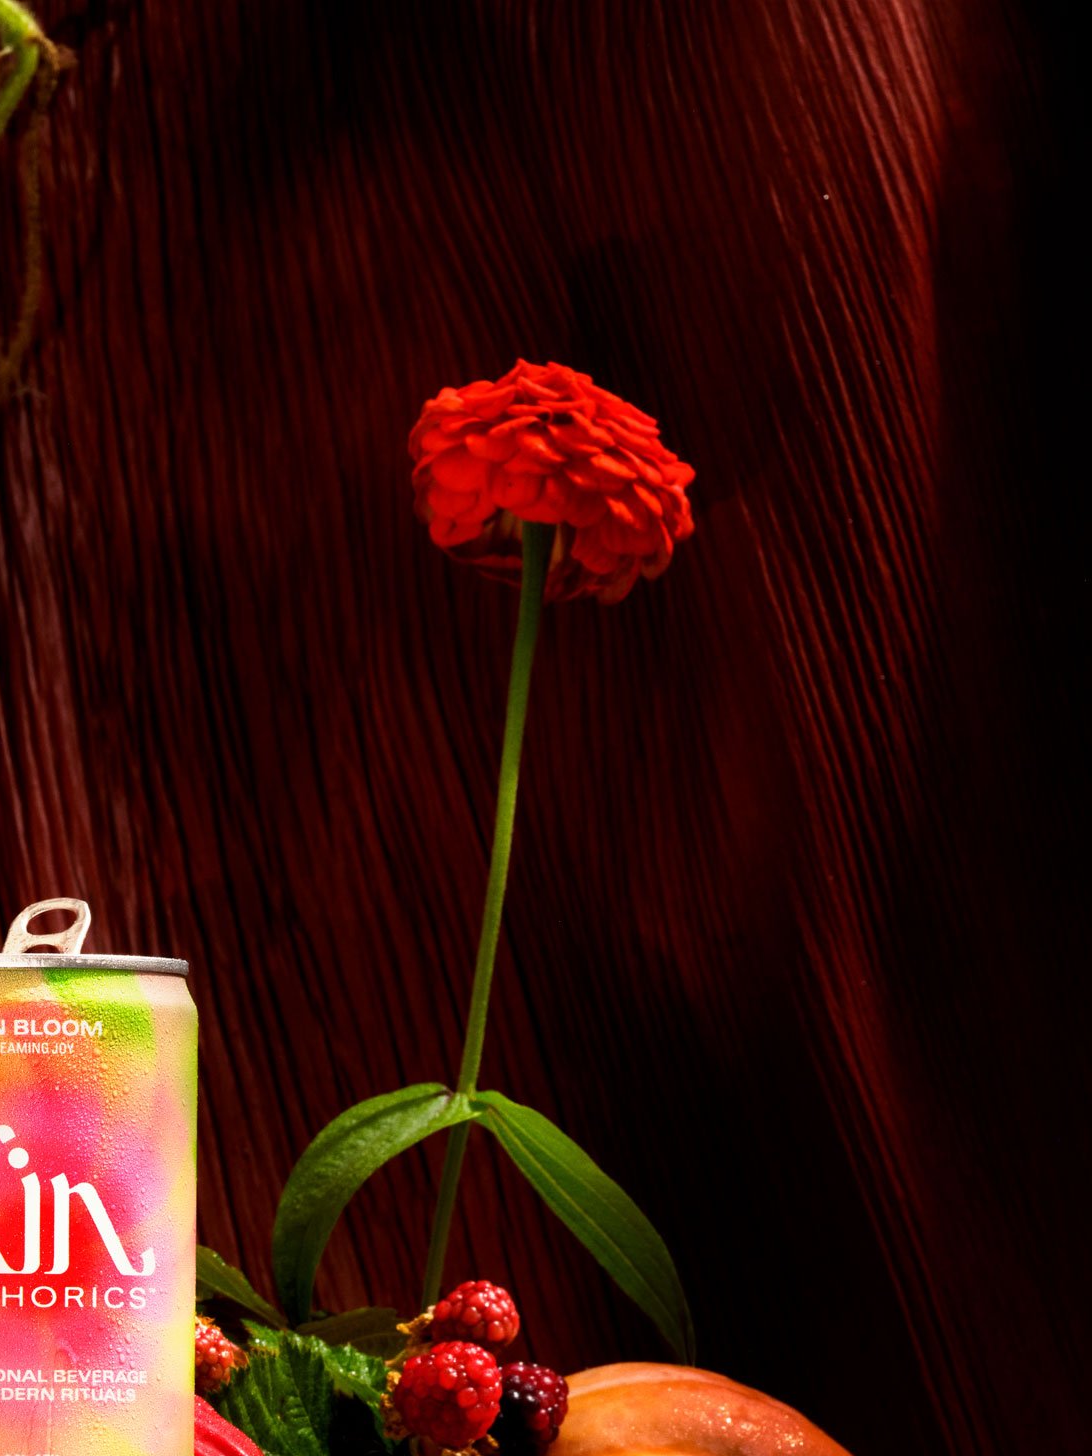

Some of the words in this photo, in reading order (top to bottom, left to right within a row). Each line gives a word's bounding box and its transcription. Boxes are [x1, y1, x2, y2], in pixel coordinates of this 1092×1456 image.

[13, 1019, 103, 1037] BLOOM
[51, 1042, 75, 1055] JOY
[53, 1369, 148, 1384] BEVERAGE
[60, 1387, 136, 1402] RITUALS
